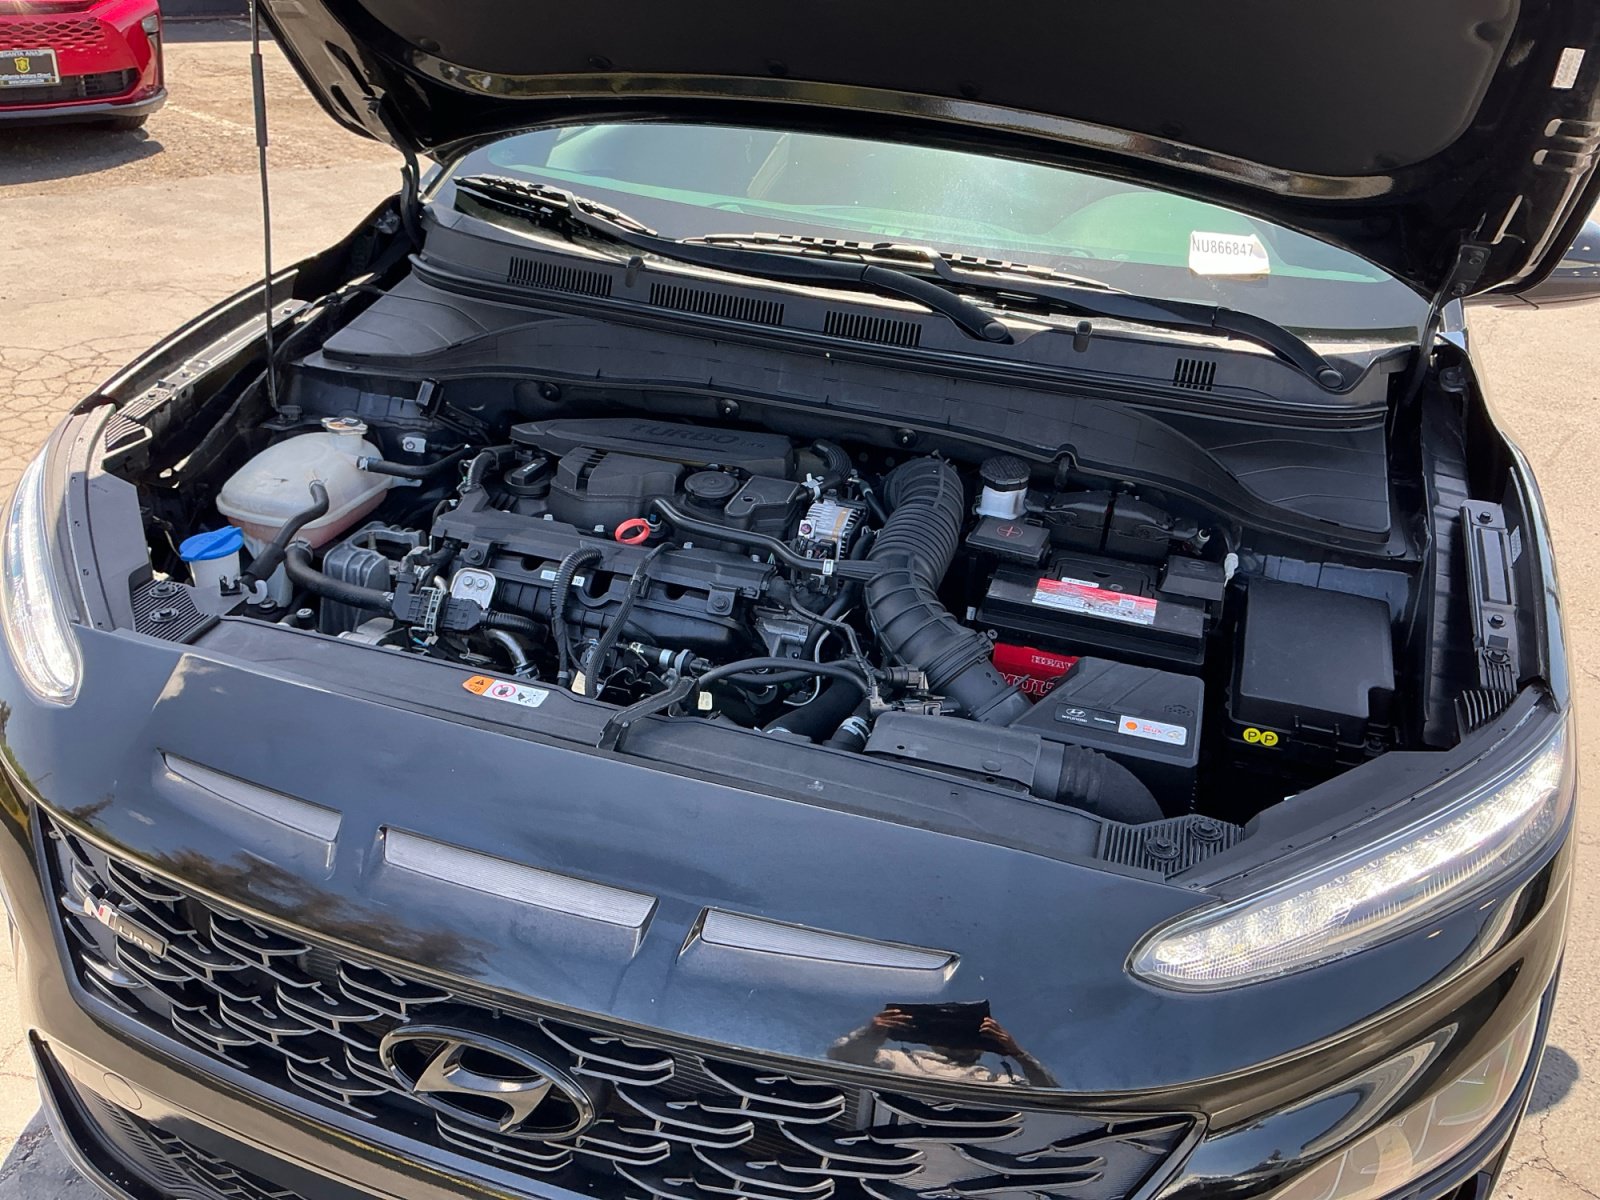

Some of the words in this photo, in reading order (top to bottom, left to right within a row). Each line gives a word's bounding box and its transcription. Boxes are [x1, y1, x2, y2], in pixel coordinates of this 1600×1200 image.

[1192, 234, 1254, 256] NU866847
[630, 423, 739, 444] TURBO
[118, 925, 154, 950] Line
